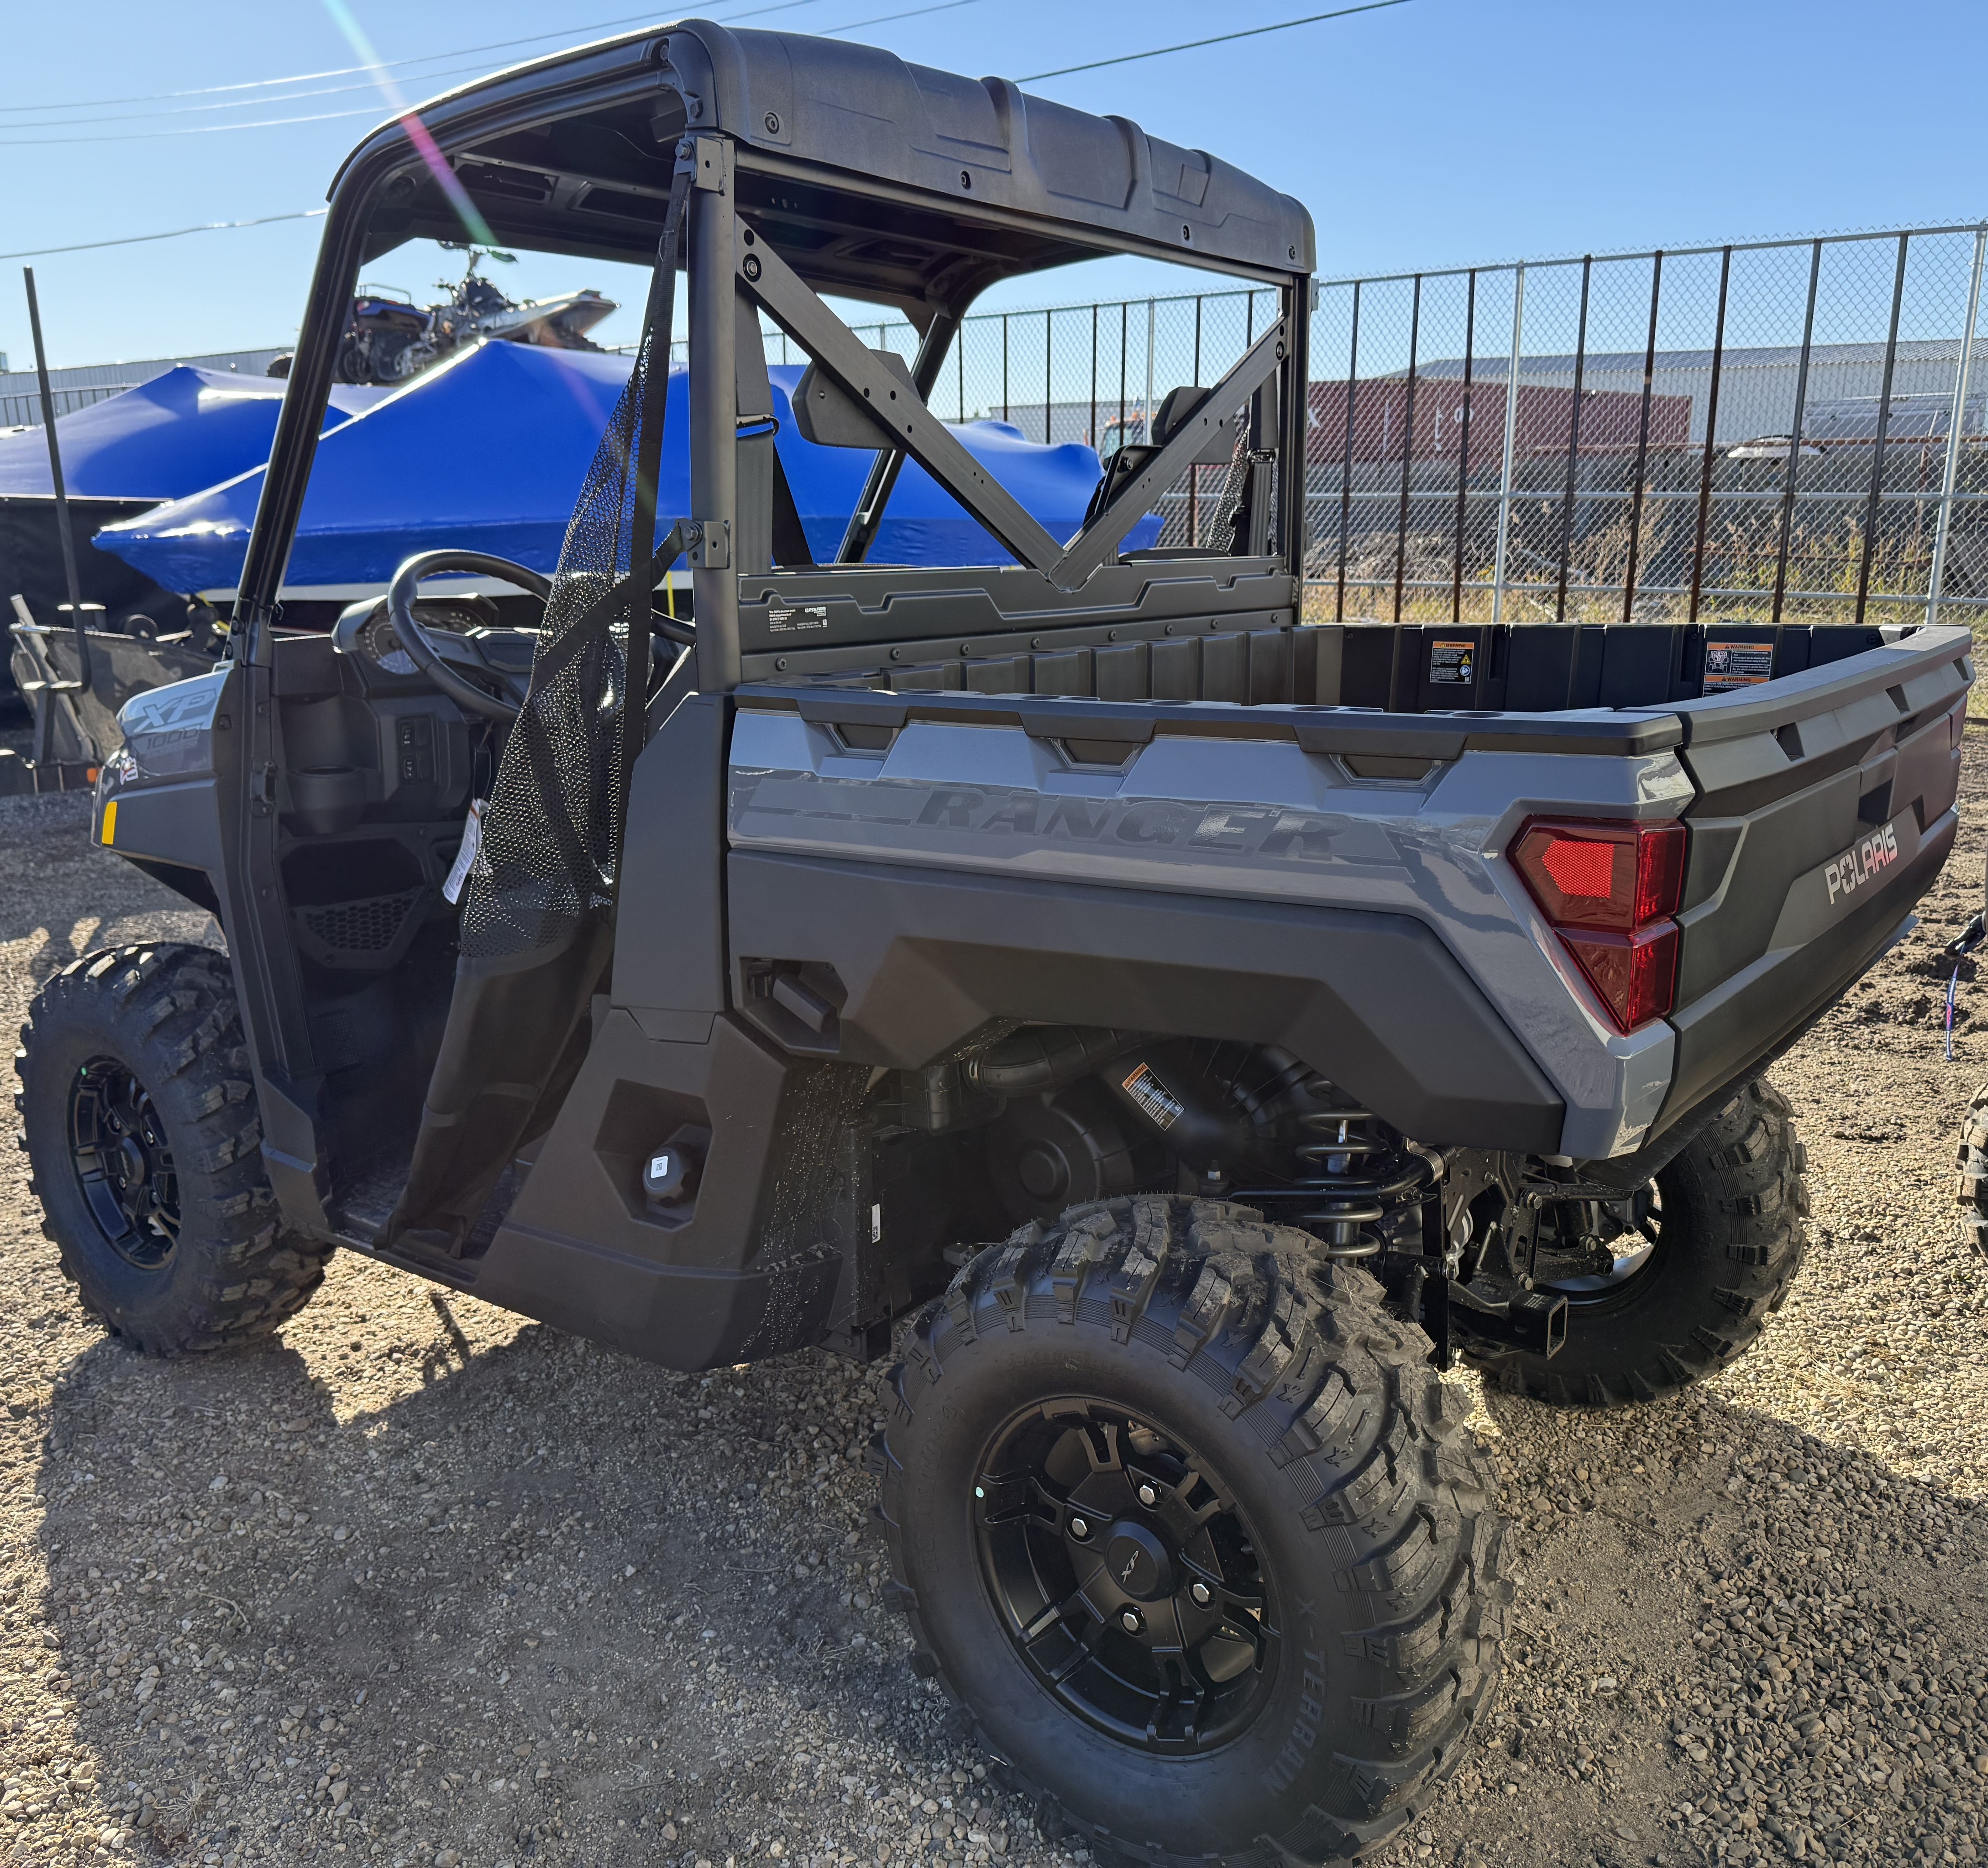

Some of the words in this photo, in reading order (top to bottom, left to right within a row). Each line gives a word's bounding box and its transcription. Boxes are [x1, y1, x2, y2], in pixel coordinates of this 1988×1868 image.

[134, 688, 217, 733] XP
[147, 726, 199, 750] 1000
[915, 789, 1349, 861] RANGER
[1825, 823, 1897, 904] POLARIS
[1127, 1064, 1147, 1084] WARNING
